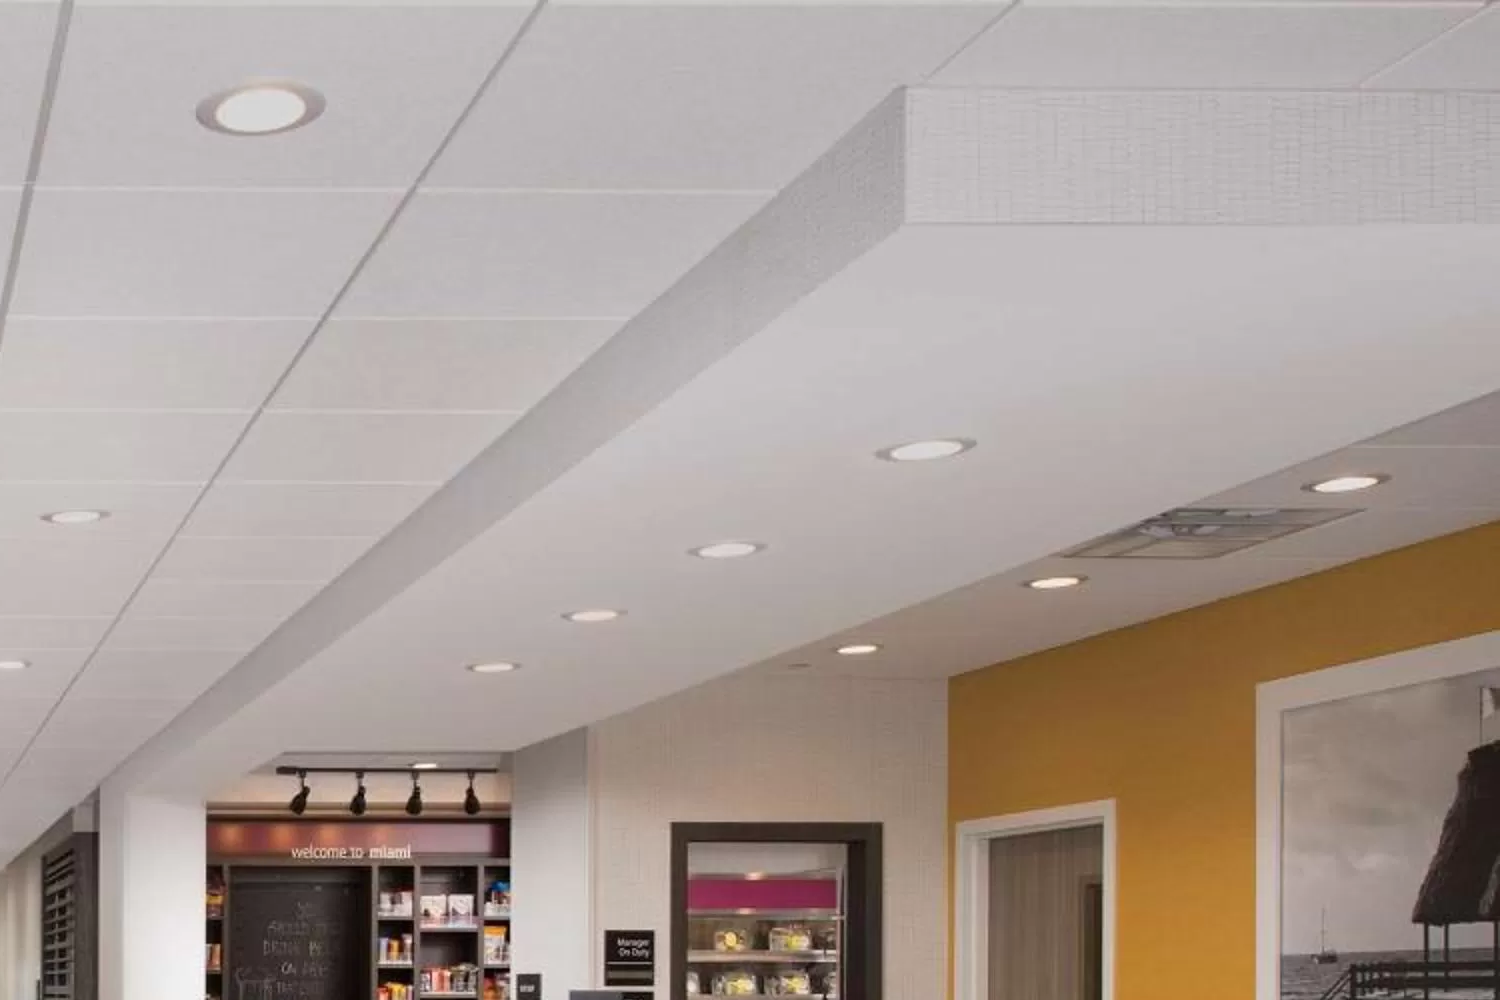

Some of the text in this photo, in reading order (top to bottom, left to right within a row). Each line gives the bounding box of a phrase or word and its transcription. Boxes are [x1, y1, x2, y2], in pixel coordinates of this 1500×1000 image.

[291, 843, 411, 860] welcome to miami
[617, 938, 649, 949] Manager
